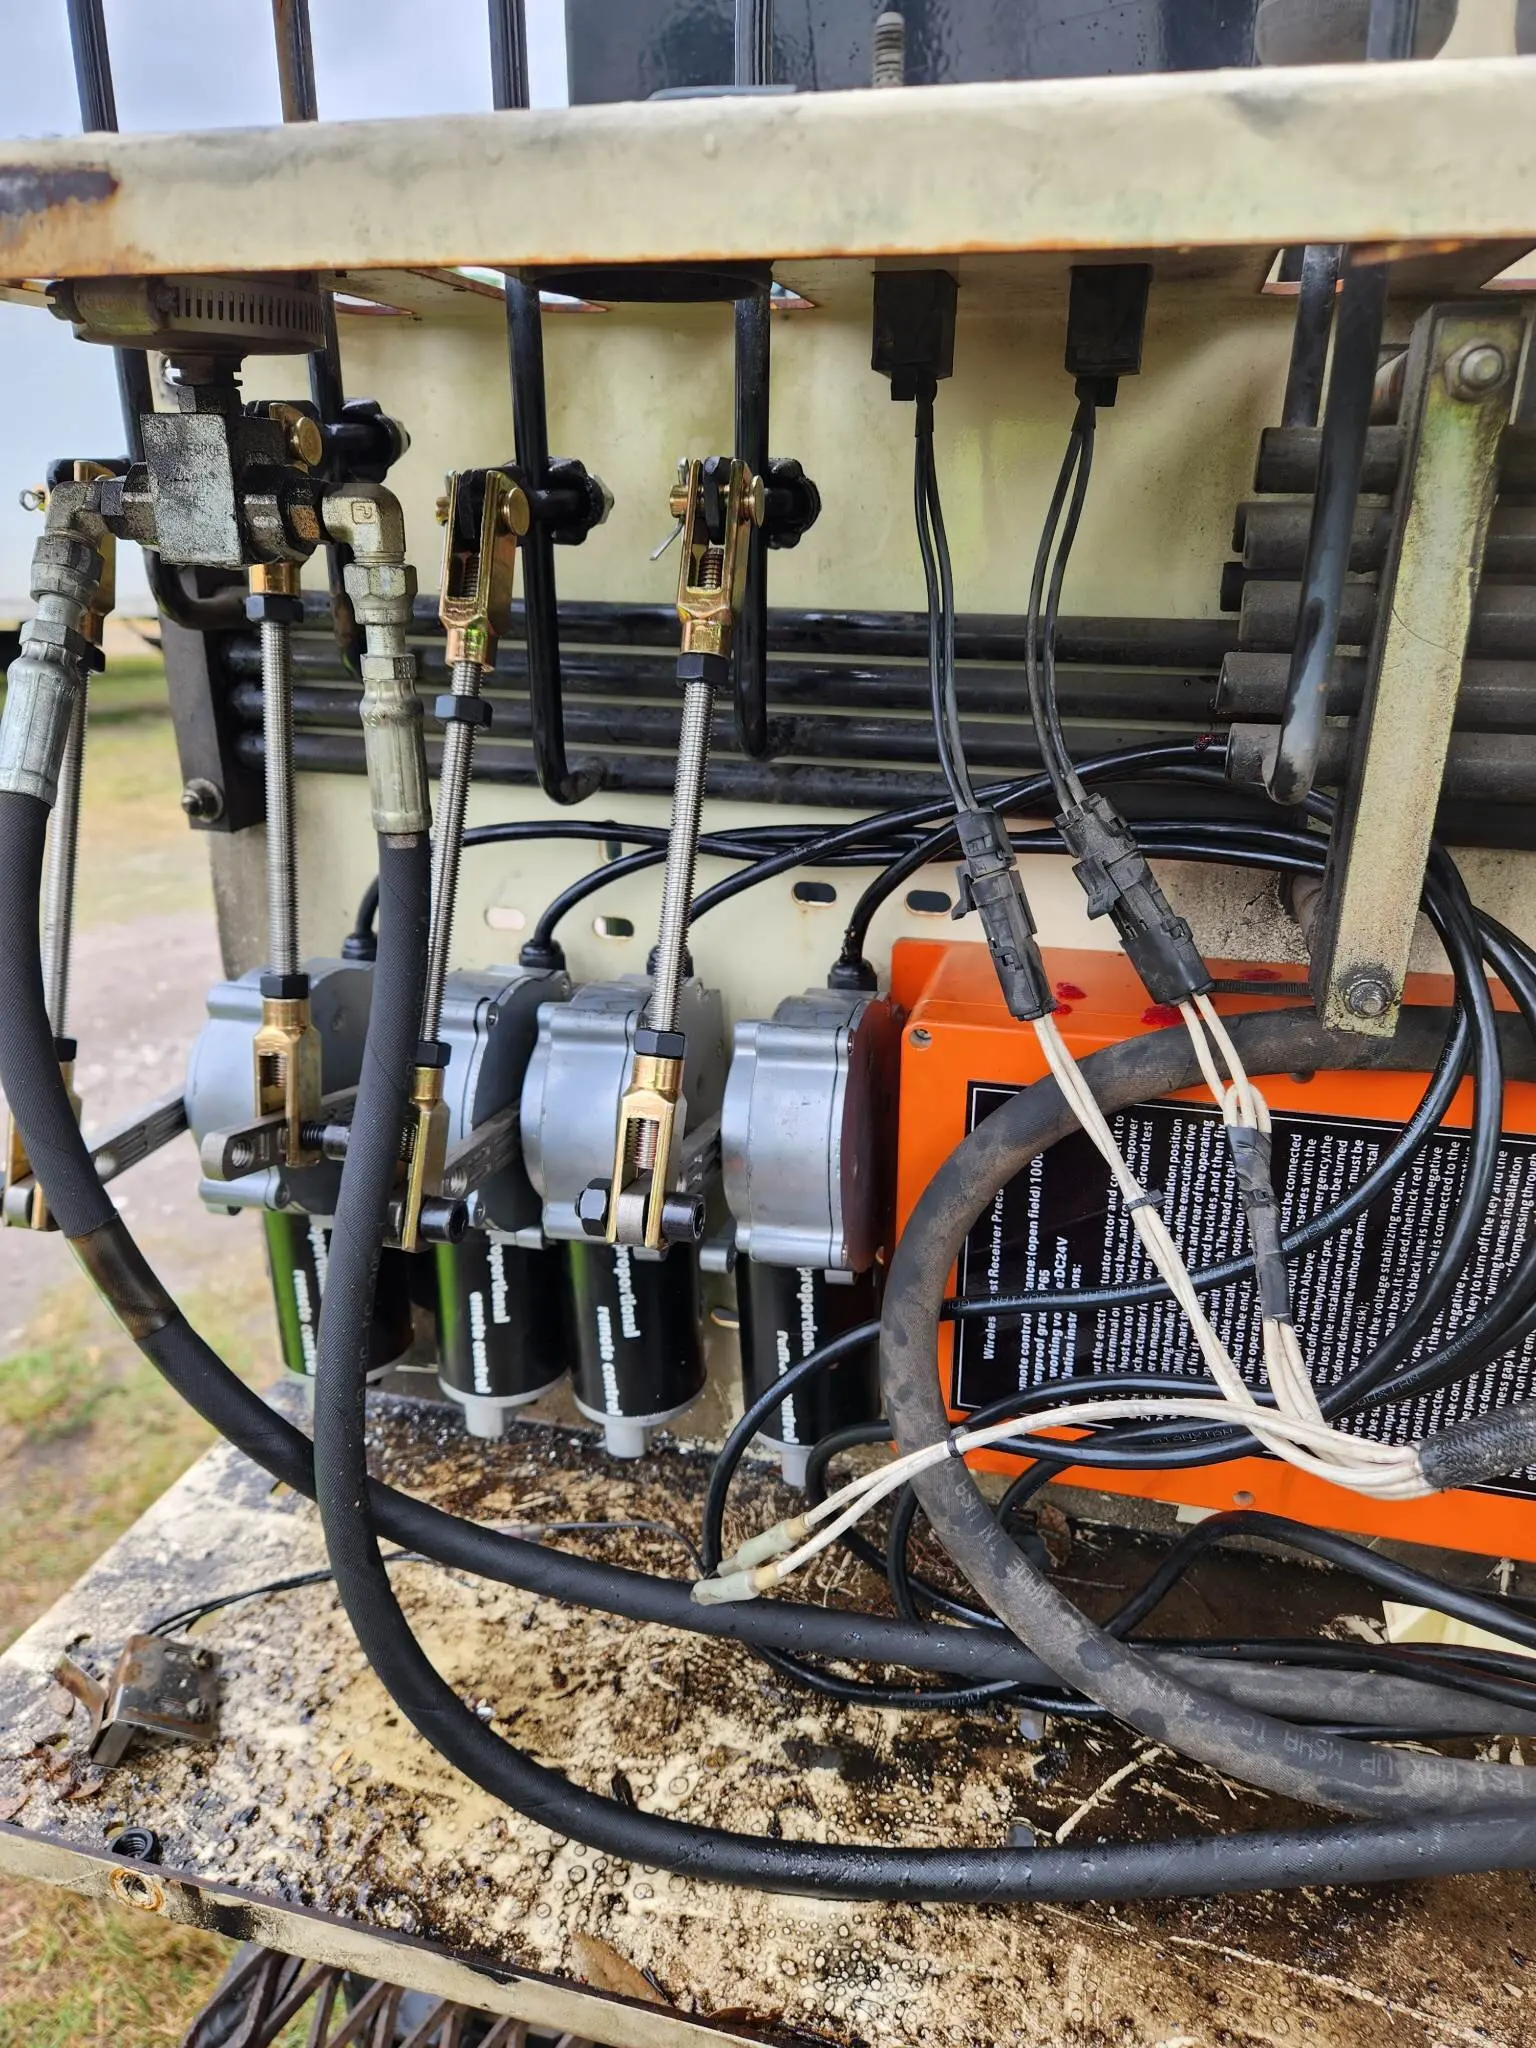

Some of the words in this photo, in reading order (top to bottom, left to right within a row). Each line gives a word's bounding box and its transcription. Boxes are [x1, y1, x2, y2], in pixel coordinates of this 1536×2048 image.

[1114, 1116, 1124, 1127] to
[1141, 1121, 1153, 1141] test
[1169, 1119, 1182, 1163] position
[1183, 1124, 1197, 1151] drive
[1198, 1120, 1215, 1172] operating
[1304, 1139, 1317, 1157] the
[1351, 1140, 1364, 1153] be
[1286, 1134, 1302, 1190] connected
[1333, 1140, 1348, 1176] turned
[1446, 1142, 1460, 1160] the
[1180, 1153, 1193, 1204] execution
[1302, 1160, 1313, 1185] with
[1349, 1155, 1361, 1183] must
[1426, 1147, 1443, 1195] negative
[1444, 1163, 1456, 1174] to
[1163, 1165, 1177, 1225] installation
[1224, 1180, 1234, 1200] and
[1329, 1178, 1342, 1191] be
[1503, 1157, 1523, 1218] installation
[1107, 1190, 1117, 1211] and
[1281, 1192, 1294, 1205] be
[1418, 1197, 1434, 1226] Input
[1434, 1178, 1453, 1237] connected
[1192, 1204, 1202, 1225] rear
[1221, 1202, 1232, 1224] head
[1280, 1206, 1291, 1232] must
[1396, 1268, 1405, 1276] is
[1412, 1167, 1423, 1186] red
[1481, 1217, 1494, 1235] the
[1105, 1213, 1115, 1247] motor
[1189, 1226, 1199, 1246] and
[1419, 1229, 1428, 1237] is
[1491, 1219, 1510, 1261] harness
[988, 1225, 1001, 1277] Receiver
[1187, 1352, 1199, 1365] fix
[1211, 1142, 1224, 1168] then
[1337, 1228, 1353, 1260] wiring
[1380, 1215, 1401, 1273] stabilizing
[1411, 1239, 1426, 1259] line
[1430, 1240, 1442, 1248] is
[1477, 1237, 1490, 1253] off
[1100, 1249, 1111, 1283] tuator
[1300, 1250, 1317, 1287] Above,
[1346, 1250, 1362, 1289] without
[1406, 1261, 1422, 1289] black
[1472, 1255, 1487, 1278] turn
[1487, 1262, 1504, 1294] wiring
[1019, 1357, 1029, 1390] mote
[1028, 1186, 1041, 1218] field)
[1328, 1259, 1344, 1322] installation
[1373, 1275, 1390, 1315] voltage
[1470, 1280, 1481, 1291] to
[1296, 1288, 1309, 1322] switch
[1337, 1291, 1355, 1340] dismantle
[1449, 1282, 1465, 1329] negative
[1464, 1293, 1481, 1312] key
[596, 1306, 615, 1361] remote
[1124, 1315, 1133, 1326] to
[1135, 1311, 1147, 1355] actuator
[1150, 1306, 1162, 1349] measure
[1162, 1312, 1175, 1346] handle
[1235, 1313, 1247, 1330] the
[1249, 1305, 1263, 1355] operating
[1368, 1317, 1381, 1334] the
[983, 1316, 996, 1359] Wireles
[1106, 1319, 1119, 1362] terminal
[1120, 1327, 1132, 1345] box
[1234, 1332, 1244, 1342] to
[1306, 1333, 1317, 1347] off
[1321, 1324, 1334, 1344] (the
[1352, 1332, 1363, 1353] own
[1366, 1336, 1377, 1347] of
[1428, 1327, 1441, 1345] the
[1032, 1337, 1045, 1385] terproof
[1048, 1329, 1063, 1377] working
[1092, 1341, 1104, 1359] the
[1118, 1347, 1130, 1368] host
[1147, 1350, 1157, 1360] to
[1318, 1346, 1331, 1365] loss
[1336, 1342, 1347, 1358] not
[472, 1340, 492, 1394] control
[1244, 1357, 1256, 1374] the
[1315, 1367, 1328, 1383] the
[1502, 1360, 1515, 1380] gap
[1517, 1356, 1530, 1373] the
[602, 1362, 622, 1416] control
[1479, 1374, 1495, 1402] down
[1516, 1376, 1526, 1389] on
[1412, 1397, 1427, 1438] positive
[1444, 1403, 1457, 1416] be
